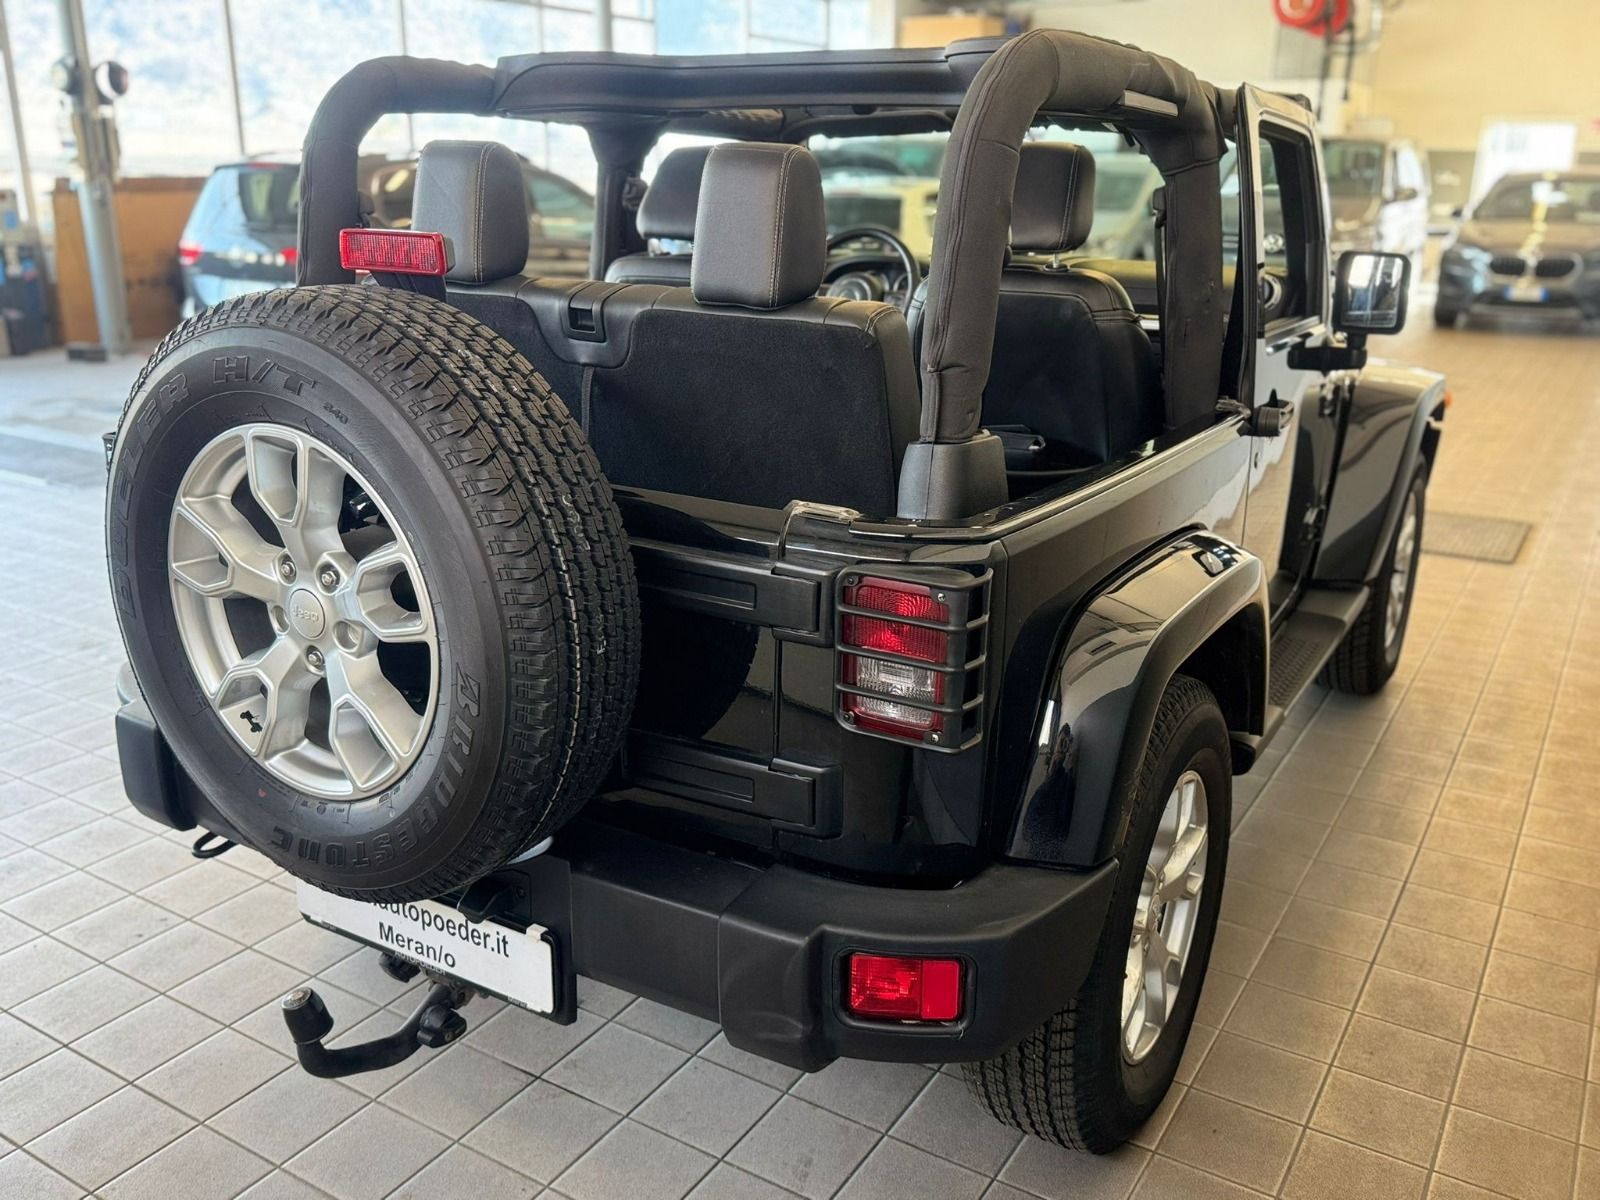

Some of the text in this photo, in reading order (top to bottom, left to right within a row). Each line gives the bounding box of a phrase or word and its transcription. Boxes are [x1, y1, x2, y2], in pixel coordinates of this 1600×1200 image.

[112, 372, 190, 619] DUELER
[213, 355, 316, 396] H/T
[292, 604, 320, 623] Jeep
[270, 663, 481, 868] BRIDGESTONE
[379, 921, 456, 968] Meran/o
